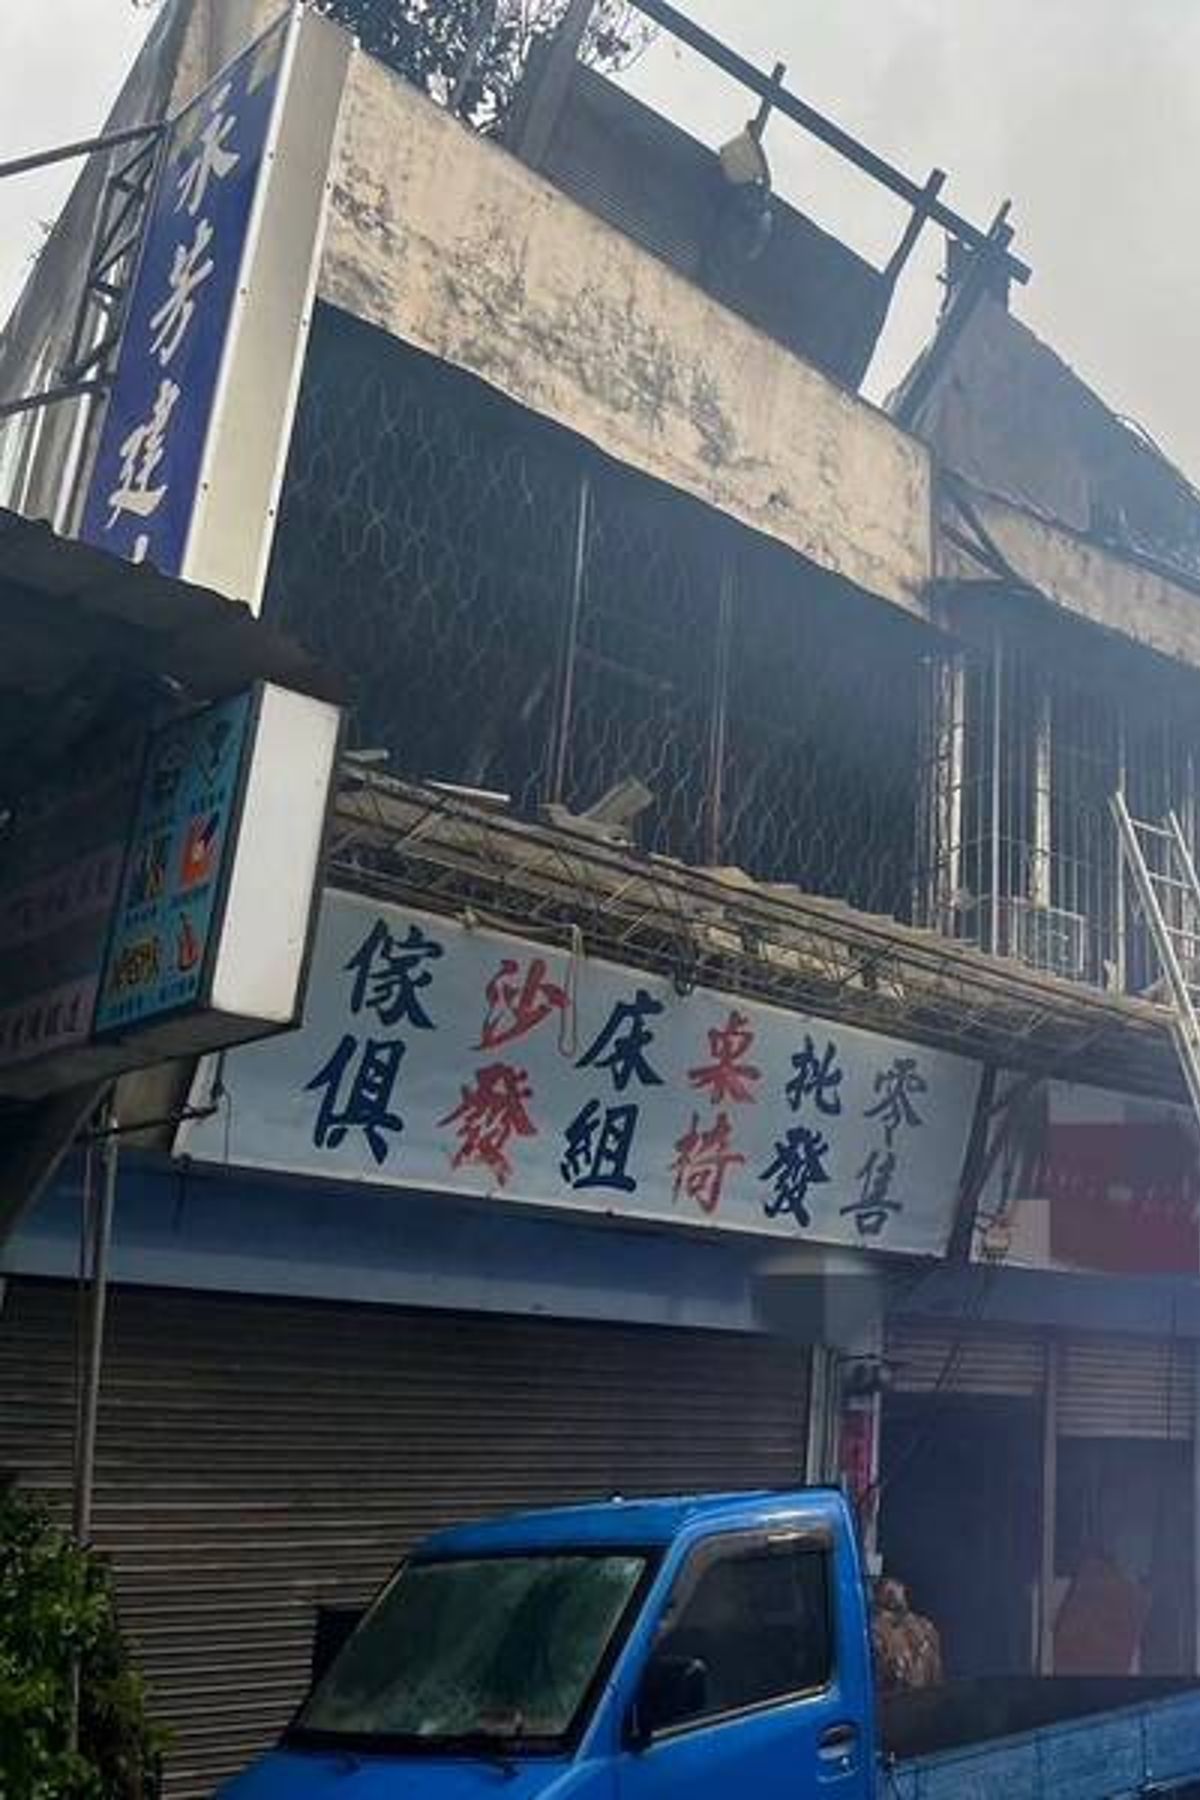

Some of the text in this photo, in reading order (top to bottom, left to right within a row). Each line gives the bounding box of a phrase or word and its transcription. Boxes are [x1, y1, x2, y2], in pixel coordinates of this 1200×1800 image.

[304, 918, 445, 1166] 傢俱
[436, 958, 568, 1187] 沙發
[560, 989, 665, 1194] 床組
[669, 1010, 762, 1213] 桌椅
[758, 1033, 843, 1229] 批發
[838, 1057, 928, 1236] 零售
